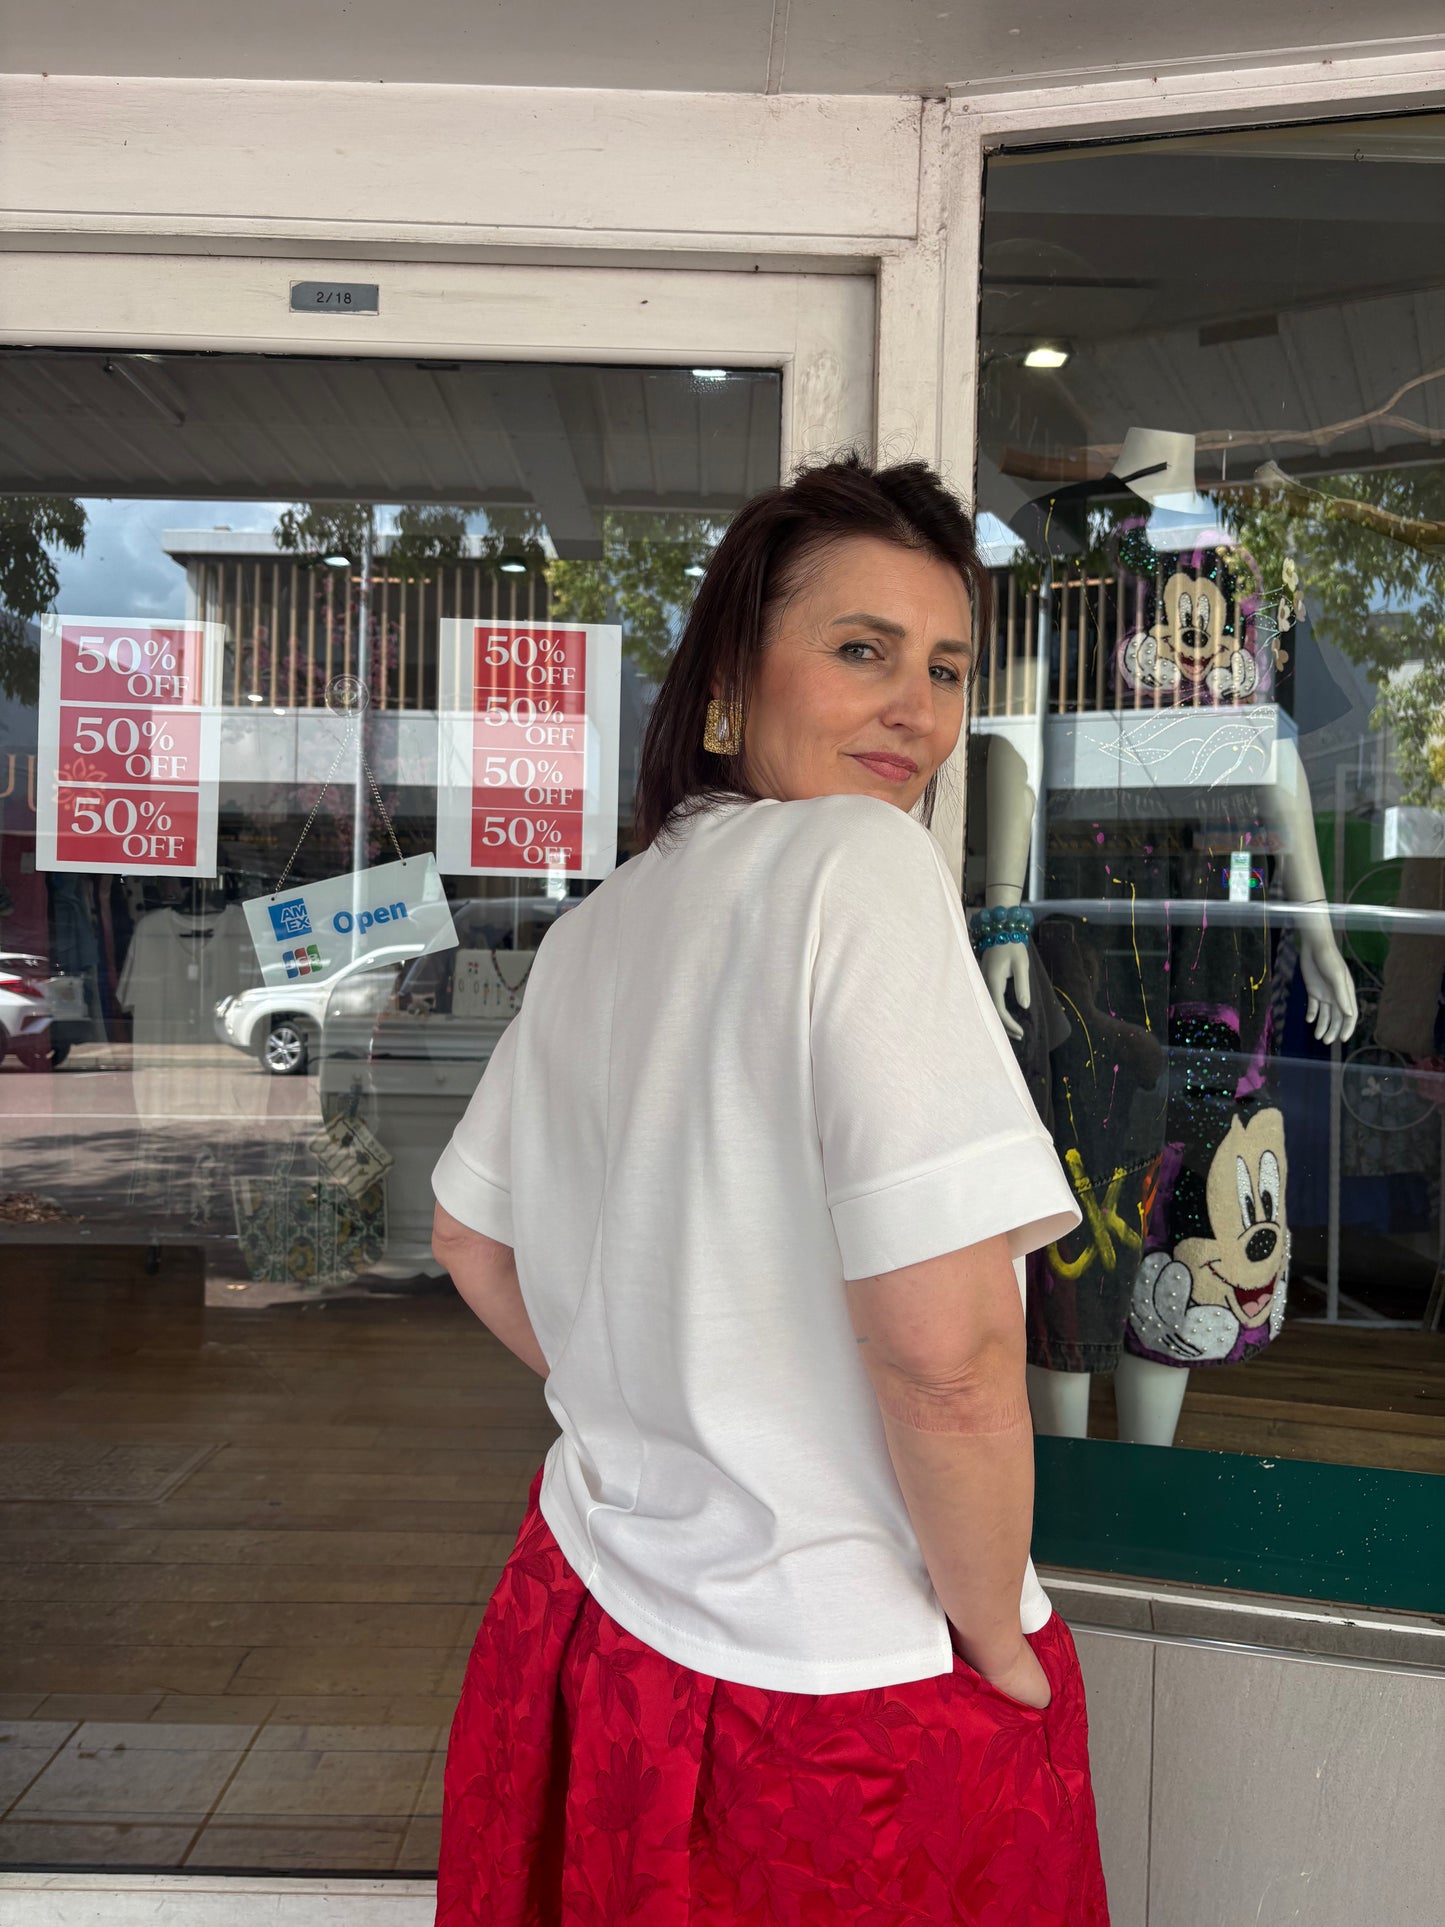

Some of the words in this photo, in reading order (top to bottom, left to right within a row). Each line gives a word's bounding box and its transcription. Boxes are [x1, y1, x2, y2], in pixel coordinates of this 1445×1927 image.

[316, 291, 352, 304] 2/18
[75, 635, 176, 675] 50%
[484, 635, 566, 667] 50%
[127, 673, 190, 698] OFF
[526, 665, 576, 686] OFF
[483, 696, 565, 728] 50%
[73, 716, 174, 756] 50%
[525, 726, 575, 746] OFF
[125, 754, 188, 779] OFF
[483, 756, 564, 788] 50%
[524, 786, 574, 806] OFF
[71, 797, 172, 836] 50%
[481, 816, 562, 847] 50%
[122, 834, 185, 859] OFF
[522, 845, 573, 865] OFF
[281, 903, 308, 923] AM
[286, 916, 311, 933] EX
[332, 901, 408, 935] Open
